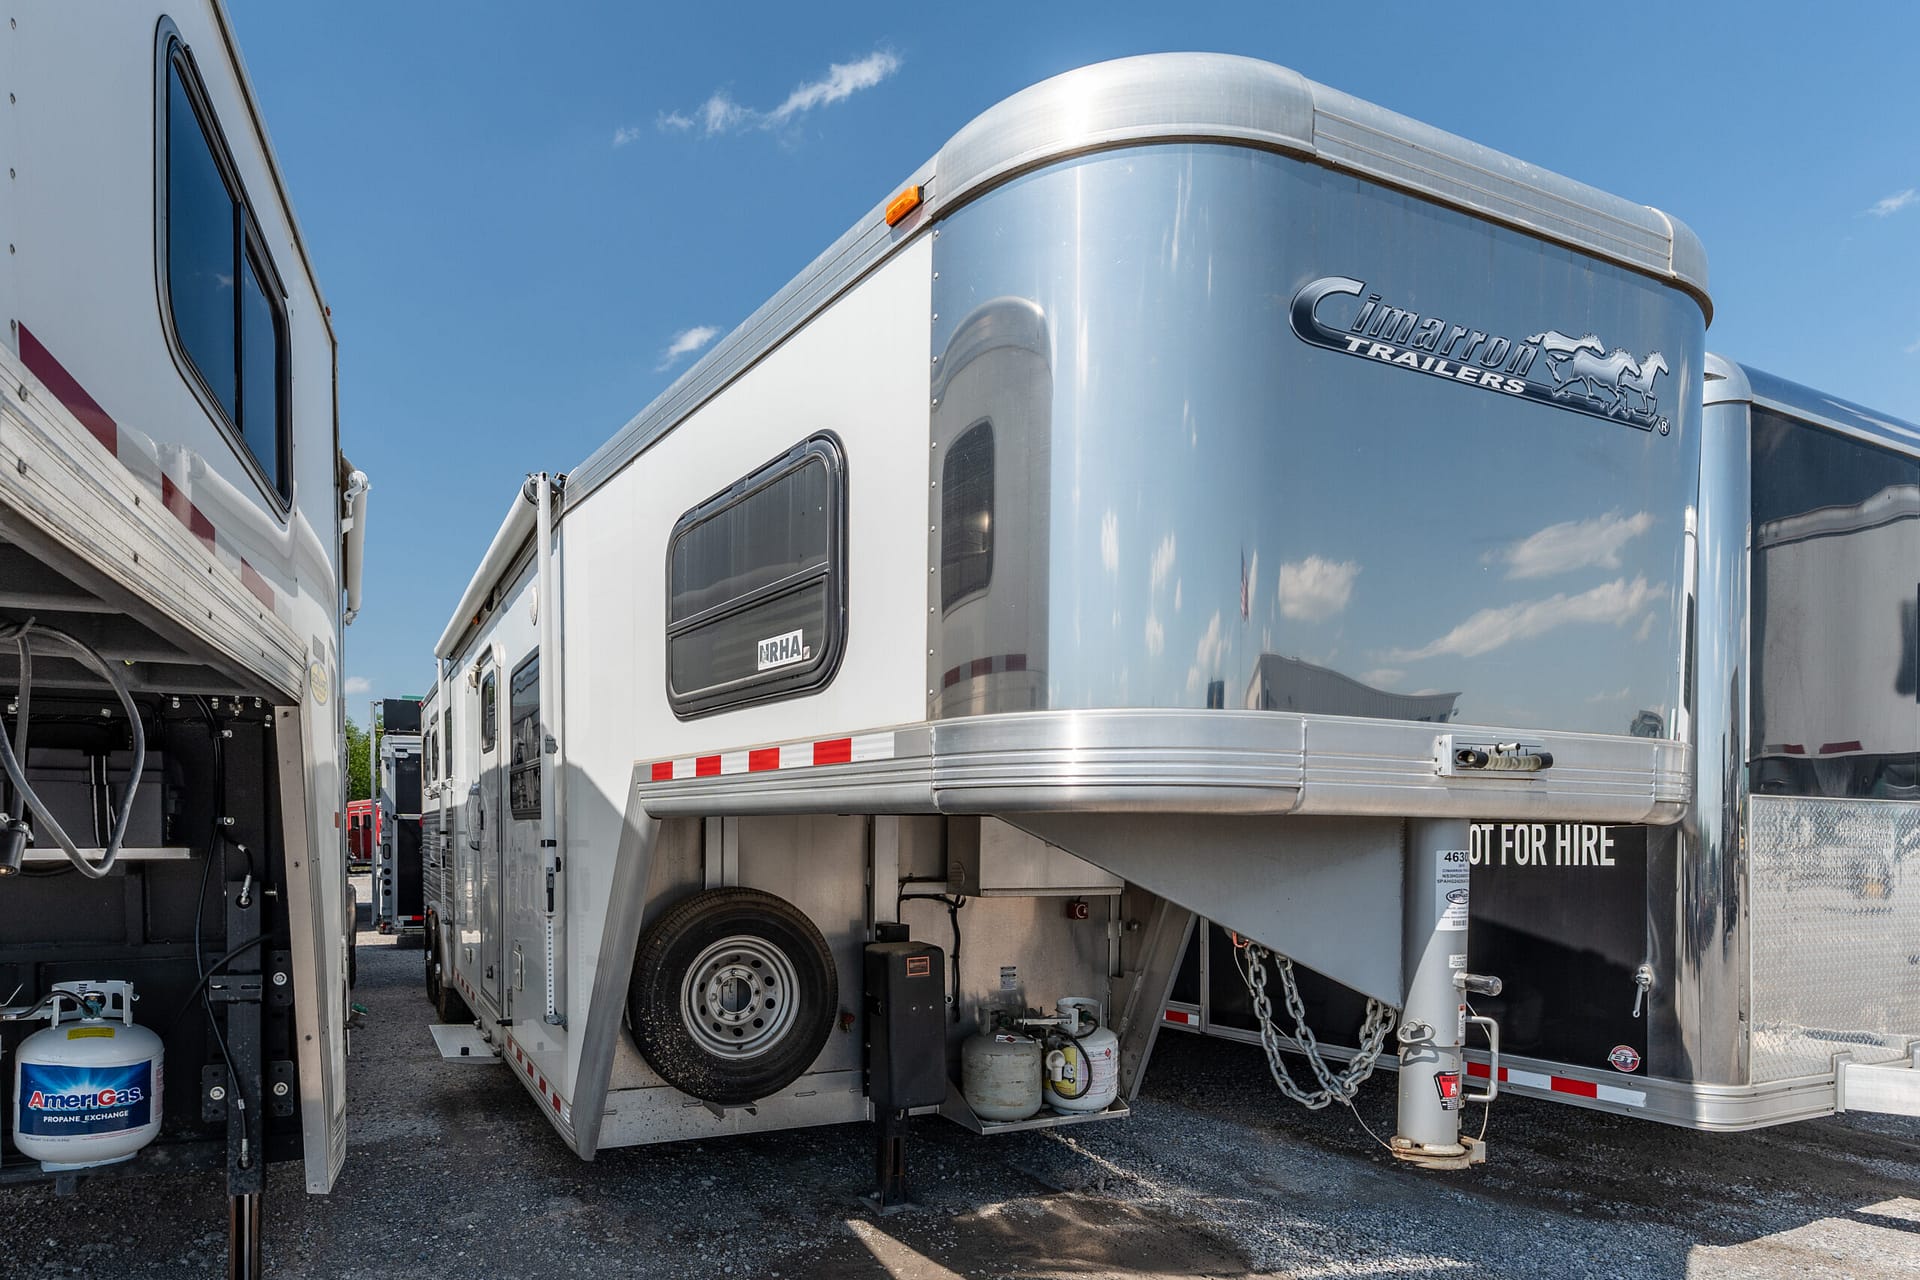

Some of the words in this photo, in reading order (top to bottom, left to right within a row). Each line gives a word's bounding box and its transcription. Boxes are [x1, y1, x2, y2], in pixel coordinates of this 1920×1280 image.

[1289, 276, 1541, 376] Cimarron
[1344, 335, 1526, 394] TRAILERS
[1469, 824, 1494, 866] OT
[1501, 824, 1547, 866] FOR
[1555, 824, 1616, 866] HIRE
[28, 1087, 142, 1110] AmeriGas
[43, 1115, 80, 1123] PROPANE
[84, 1110, 129, 1121] EXCHANGE
